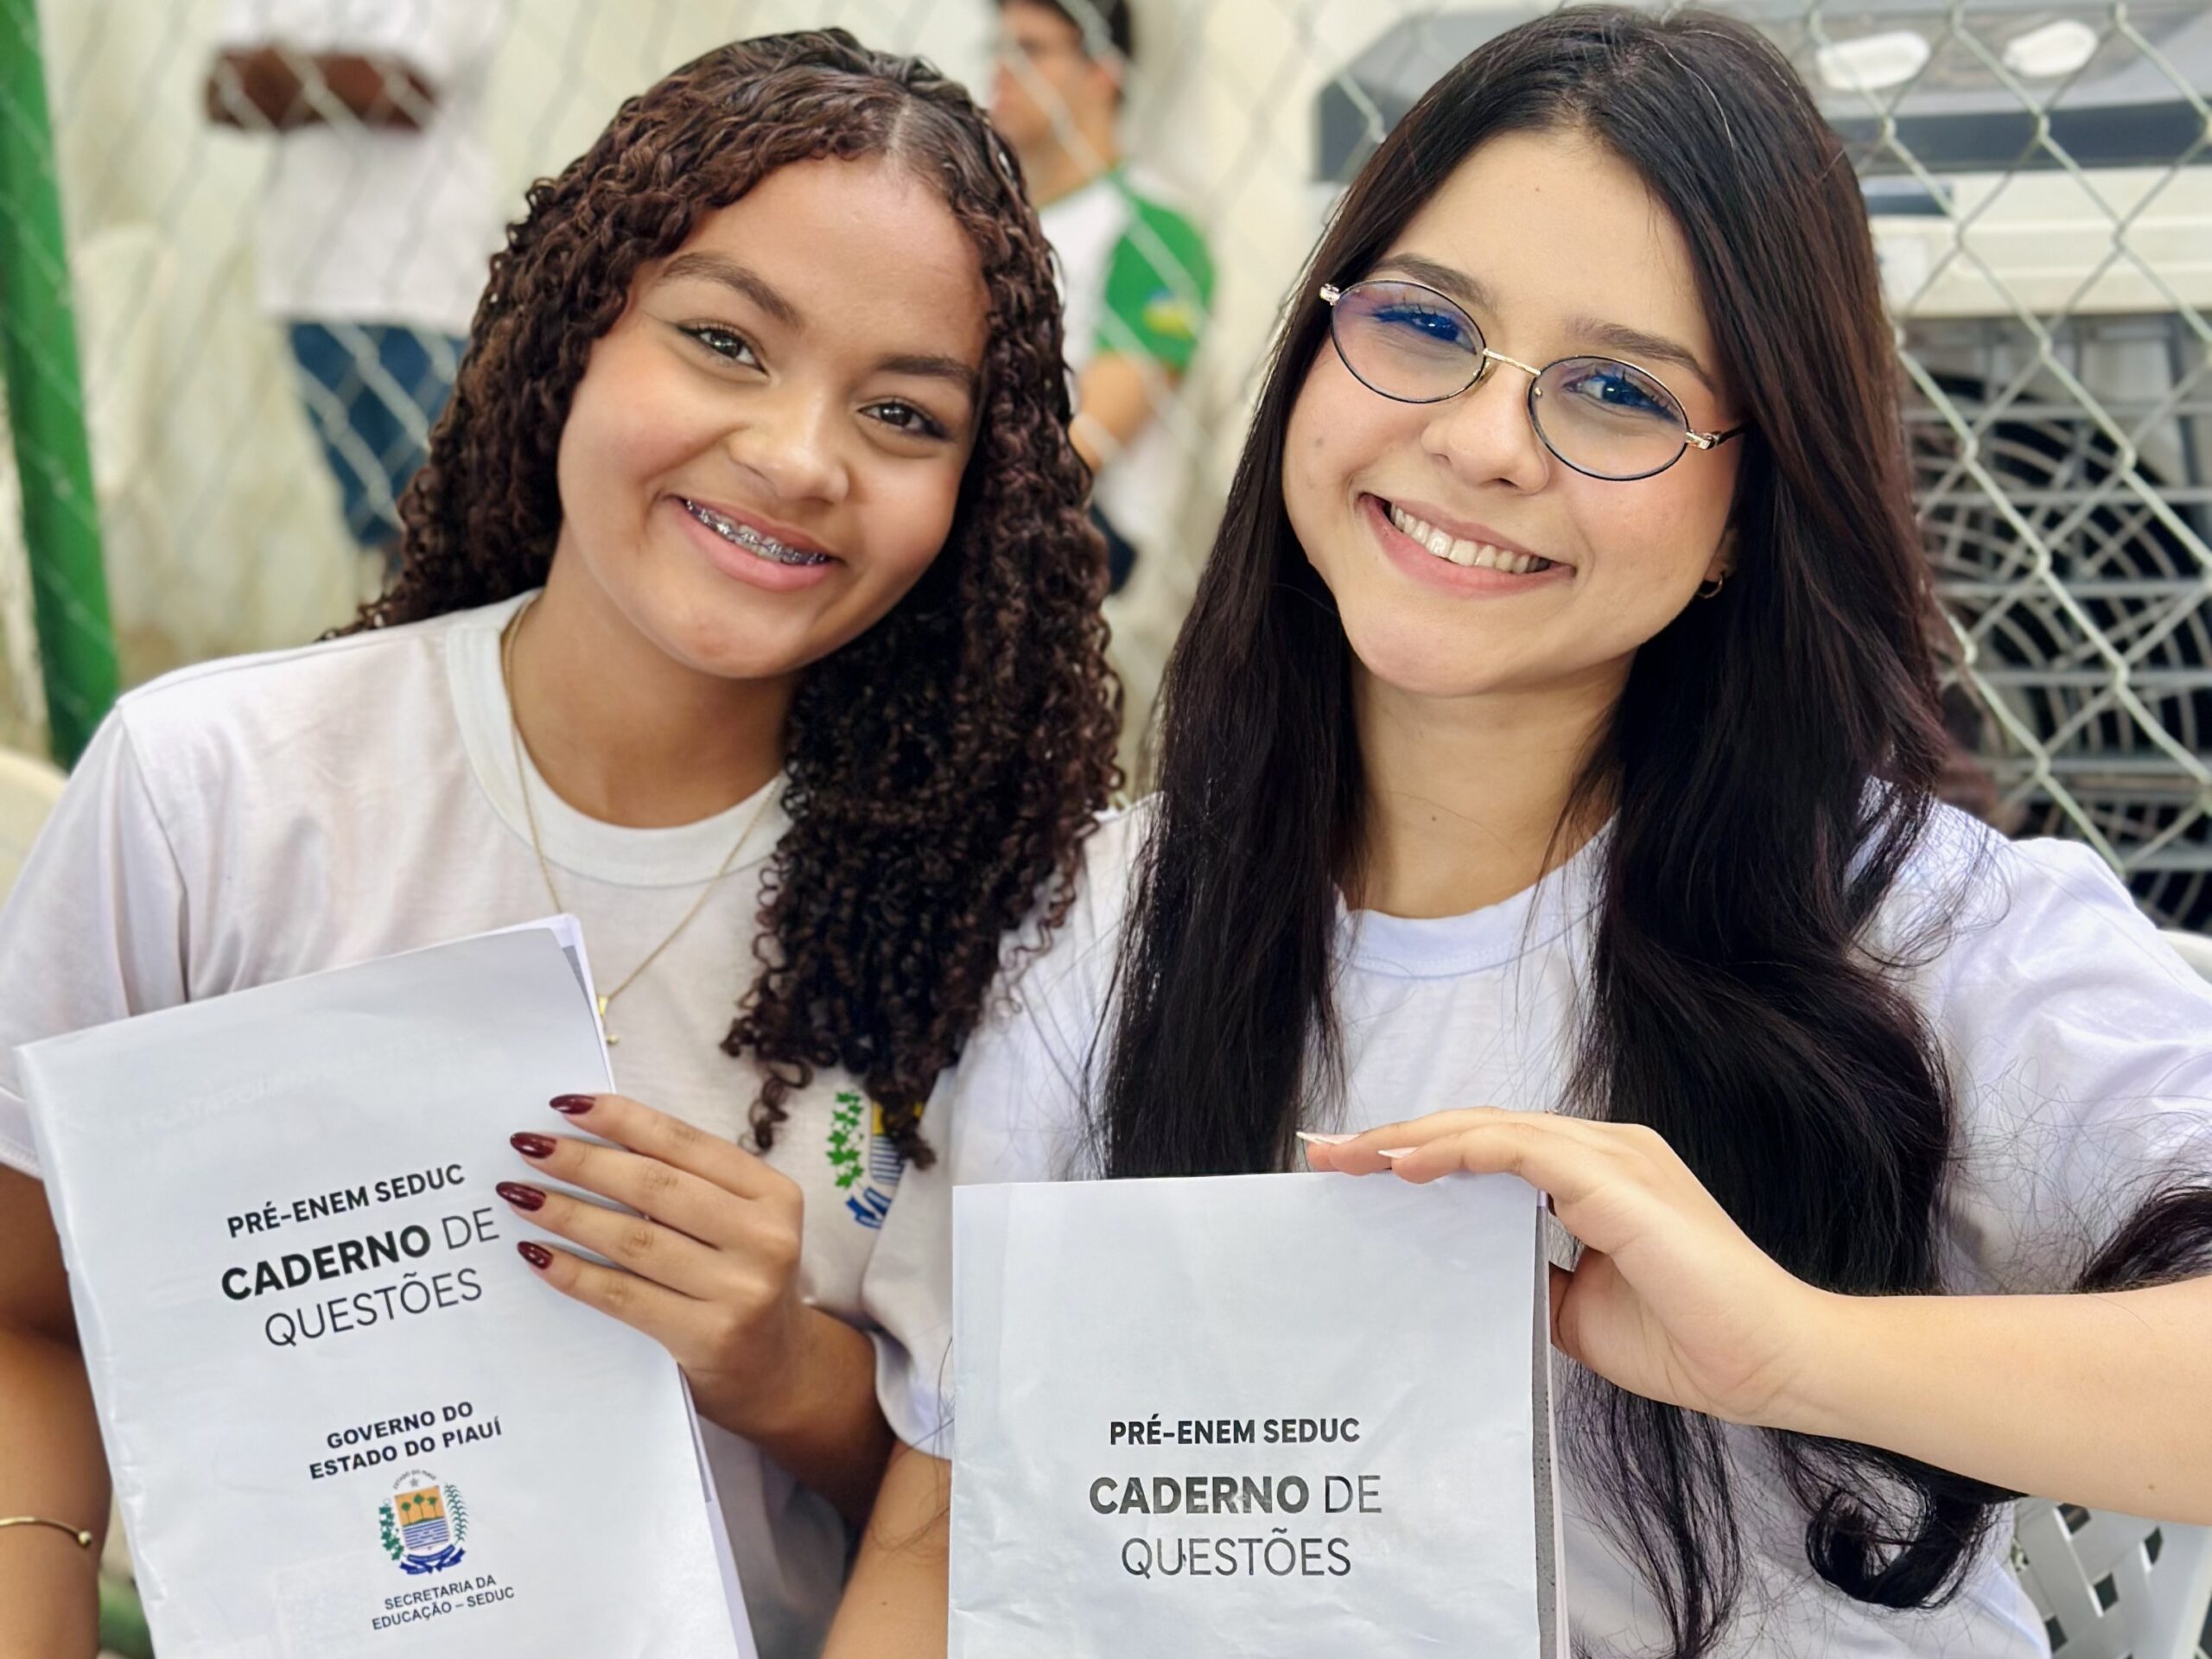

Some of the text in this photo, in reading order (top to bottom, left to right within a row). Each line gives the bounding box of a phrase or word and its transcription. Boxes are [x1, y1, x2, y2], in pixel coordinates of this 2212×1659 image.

[227, 1164, 466, 1237] PRÉ-ENEM SEDUC
[221, 1207, 500, 1300] CADERNO DE
[265, 1268, 482, 1347] QUESTÕES
[309, 1416, 502, 1479] ESTADO DO PIAUÍ
[327, 1401, 474, 1449] GOVERNO DO
[1110, 1414, 1360, 1445] PRÉ-ENEM SEDUC
[1089, 1474, 1382, 1515] CADERNO DE
[1122, 1528, 1351, 1580] QUESTÕES
[372, 1600, 452, 1630] EDUCAÇÃO
[467, 1586, 515, 1608] SEDUC
[385, 1574, 496, 1610] SECRETARIA DA
